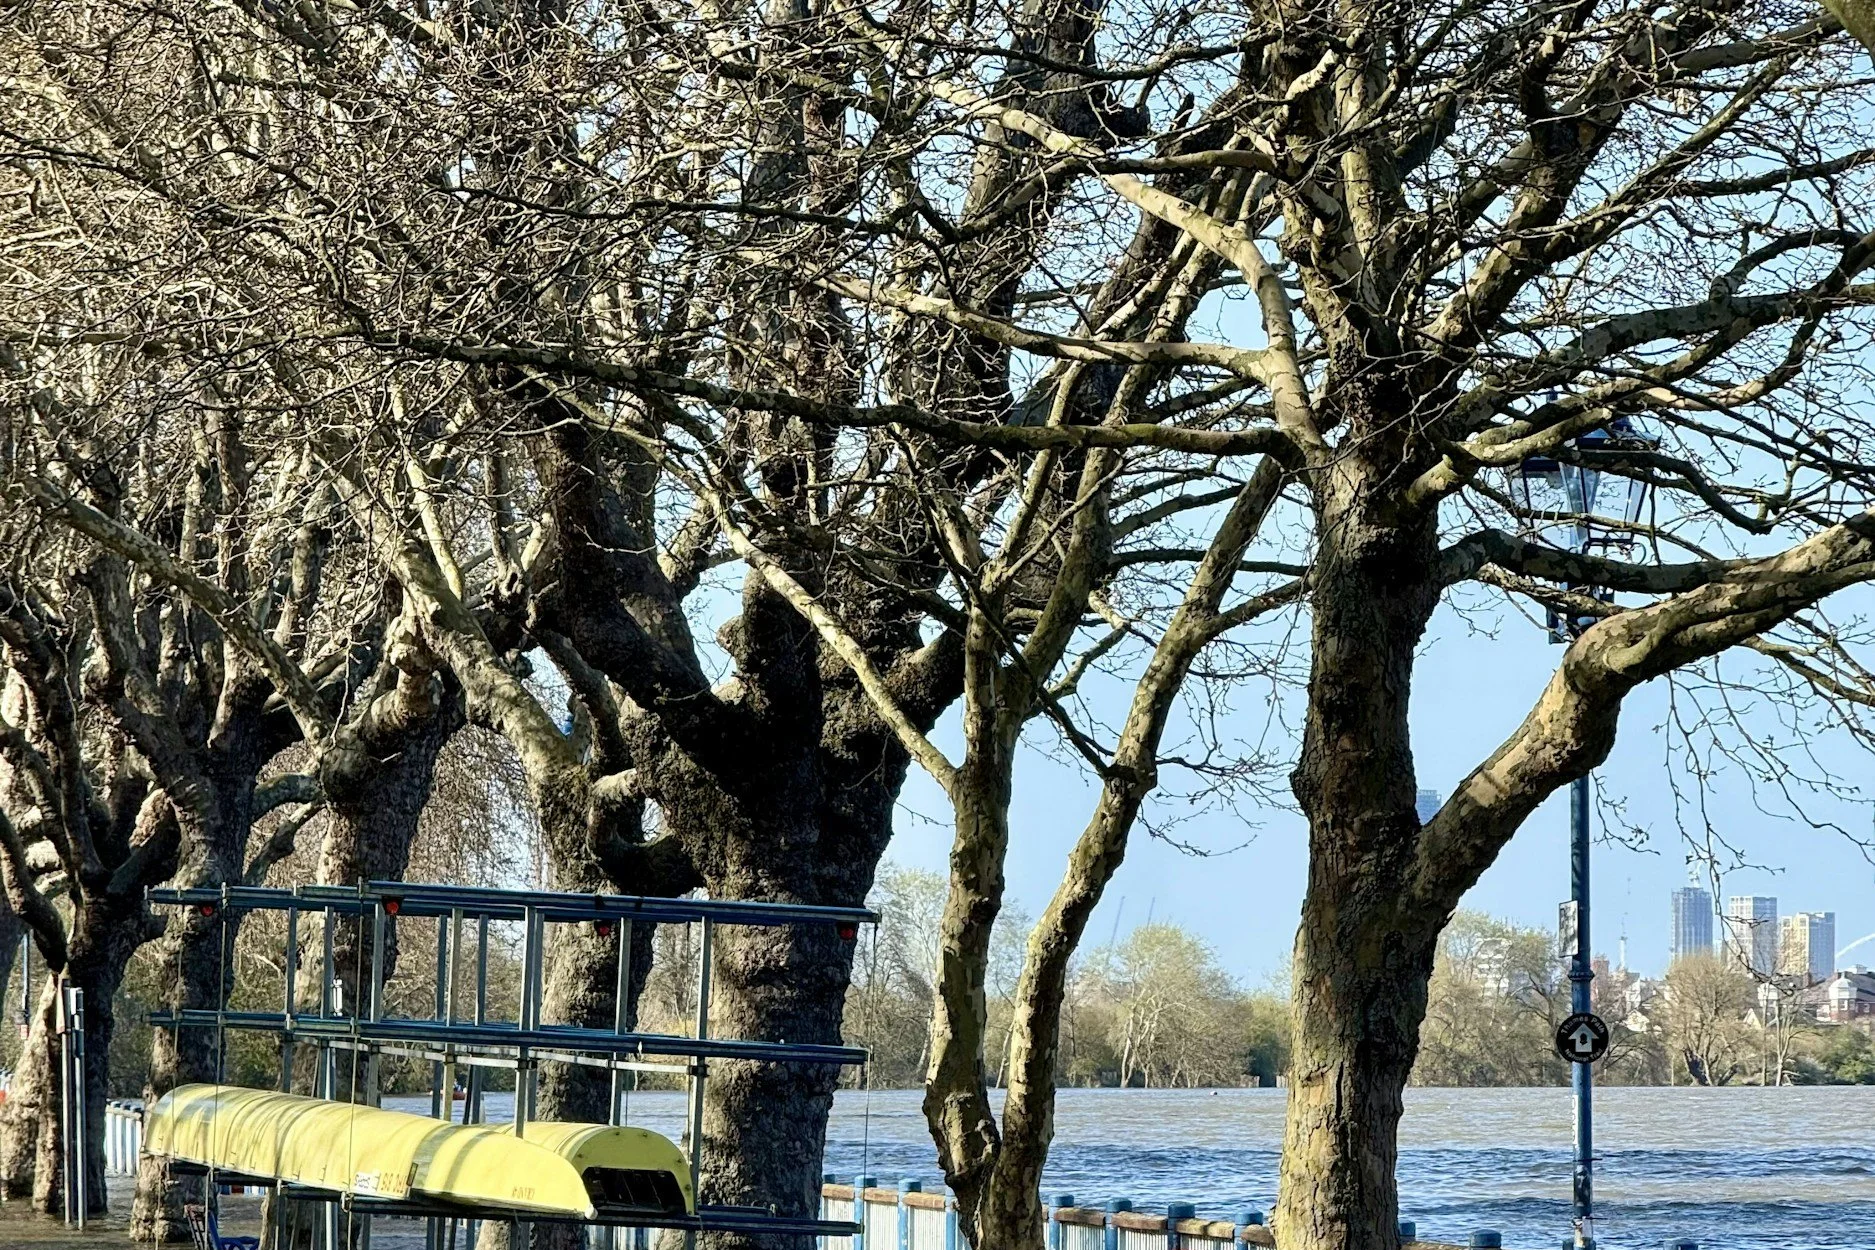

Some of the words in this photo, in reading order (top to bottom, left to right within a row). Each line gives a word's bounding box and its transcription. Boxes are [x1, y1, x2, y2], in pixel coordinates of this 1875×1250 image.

[1561, 1016, 1588, 1034] Thames
[1591, 1017, 1605, 1034] Path
[1565, 1048, 1589, 1062] National
[1590, 1048, 1603, 1060] Trail
